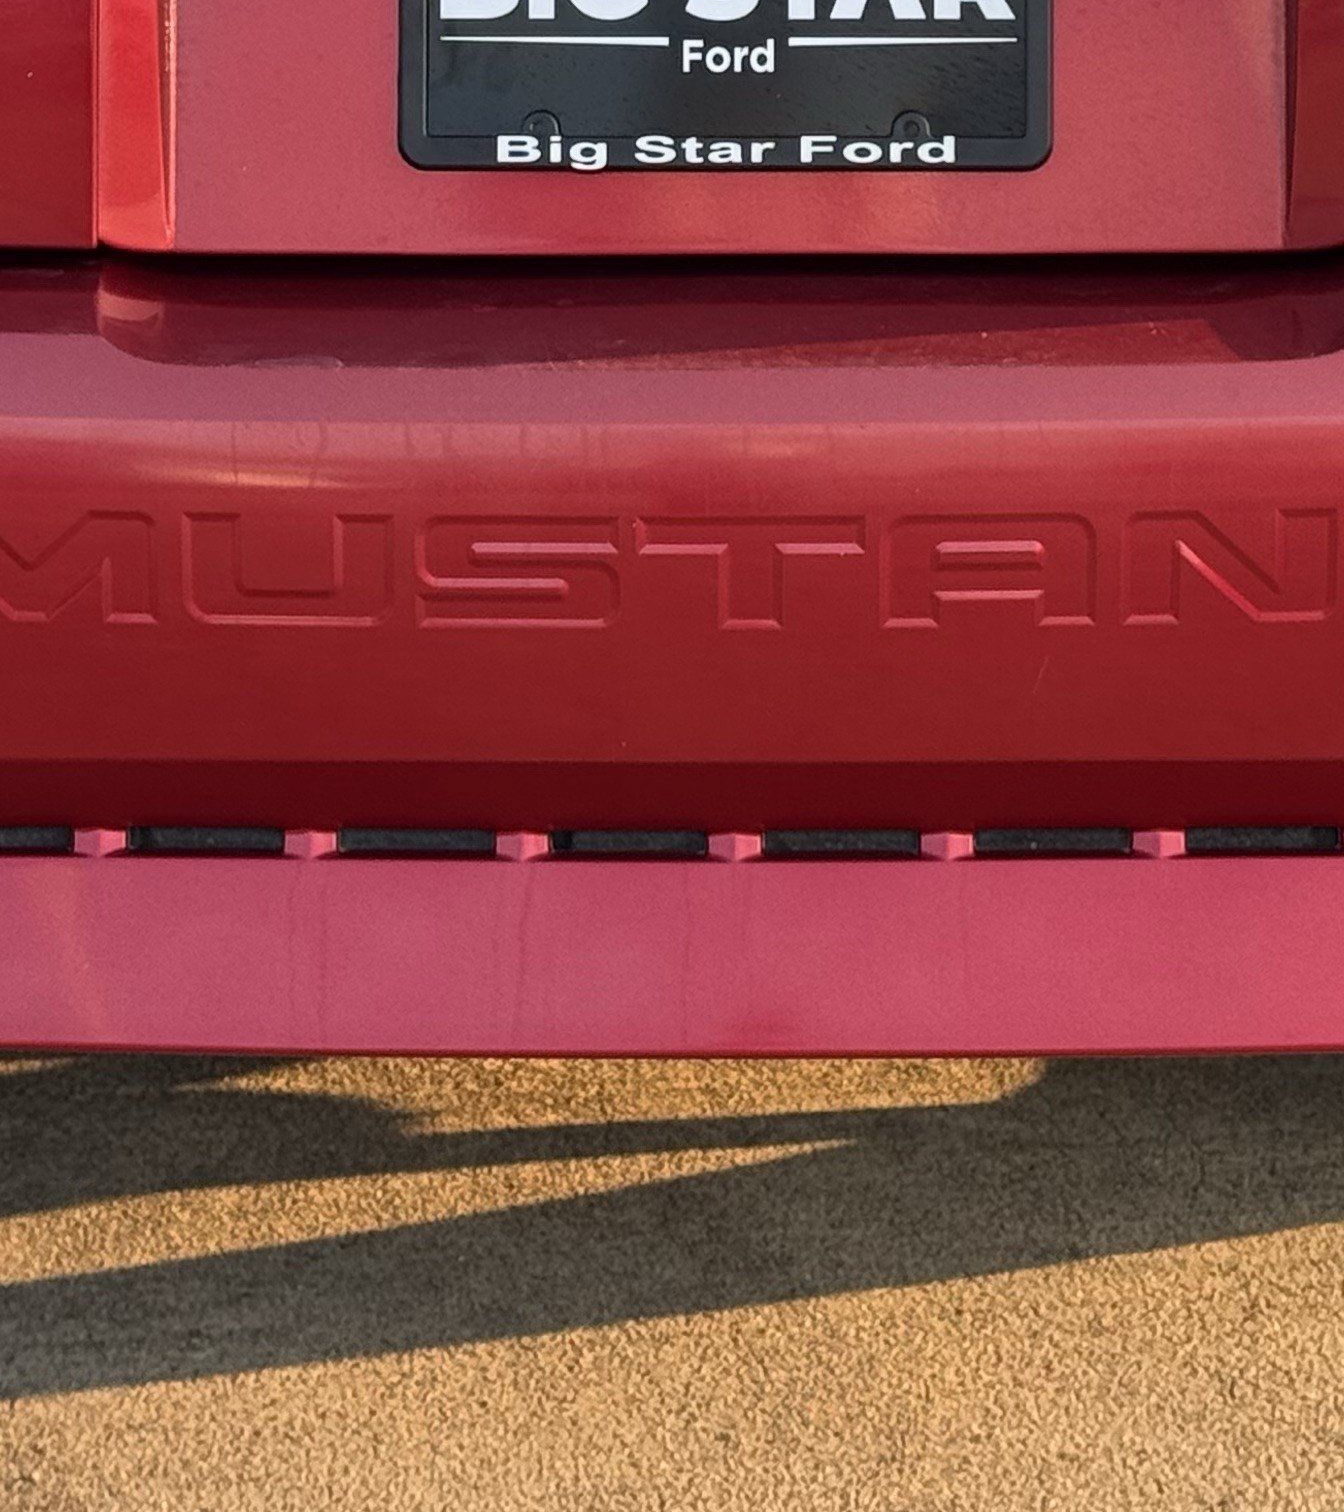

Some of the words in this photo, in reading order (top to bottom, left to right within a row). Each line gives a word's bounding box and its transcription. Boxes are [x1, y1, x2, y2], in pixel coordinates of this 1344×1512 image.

[682, 37, 775, 73] Ford
[496, 135, 608, 171] Big
[634, 135, 776, 164] Star
[800, 135, 956, 164] Ford
